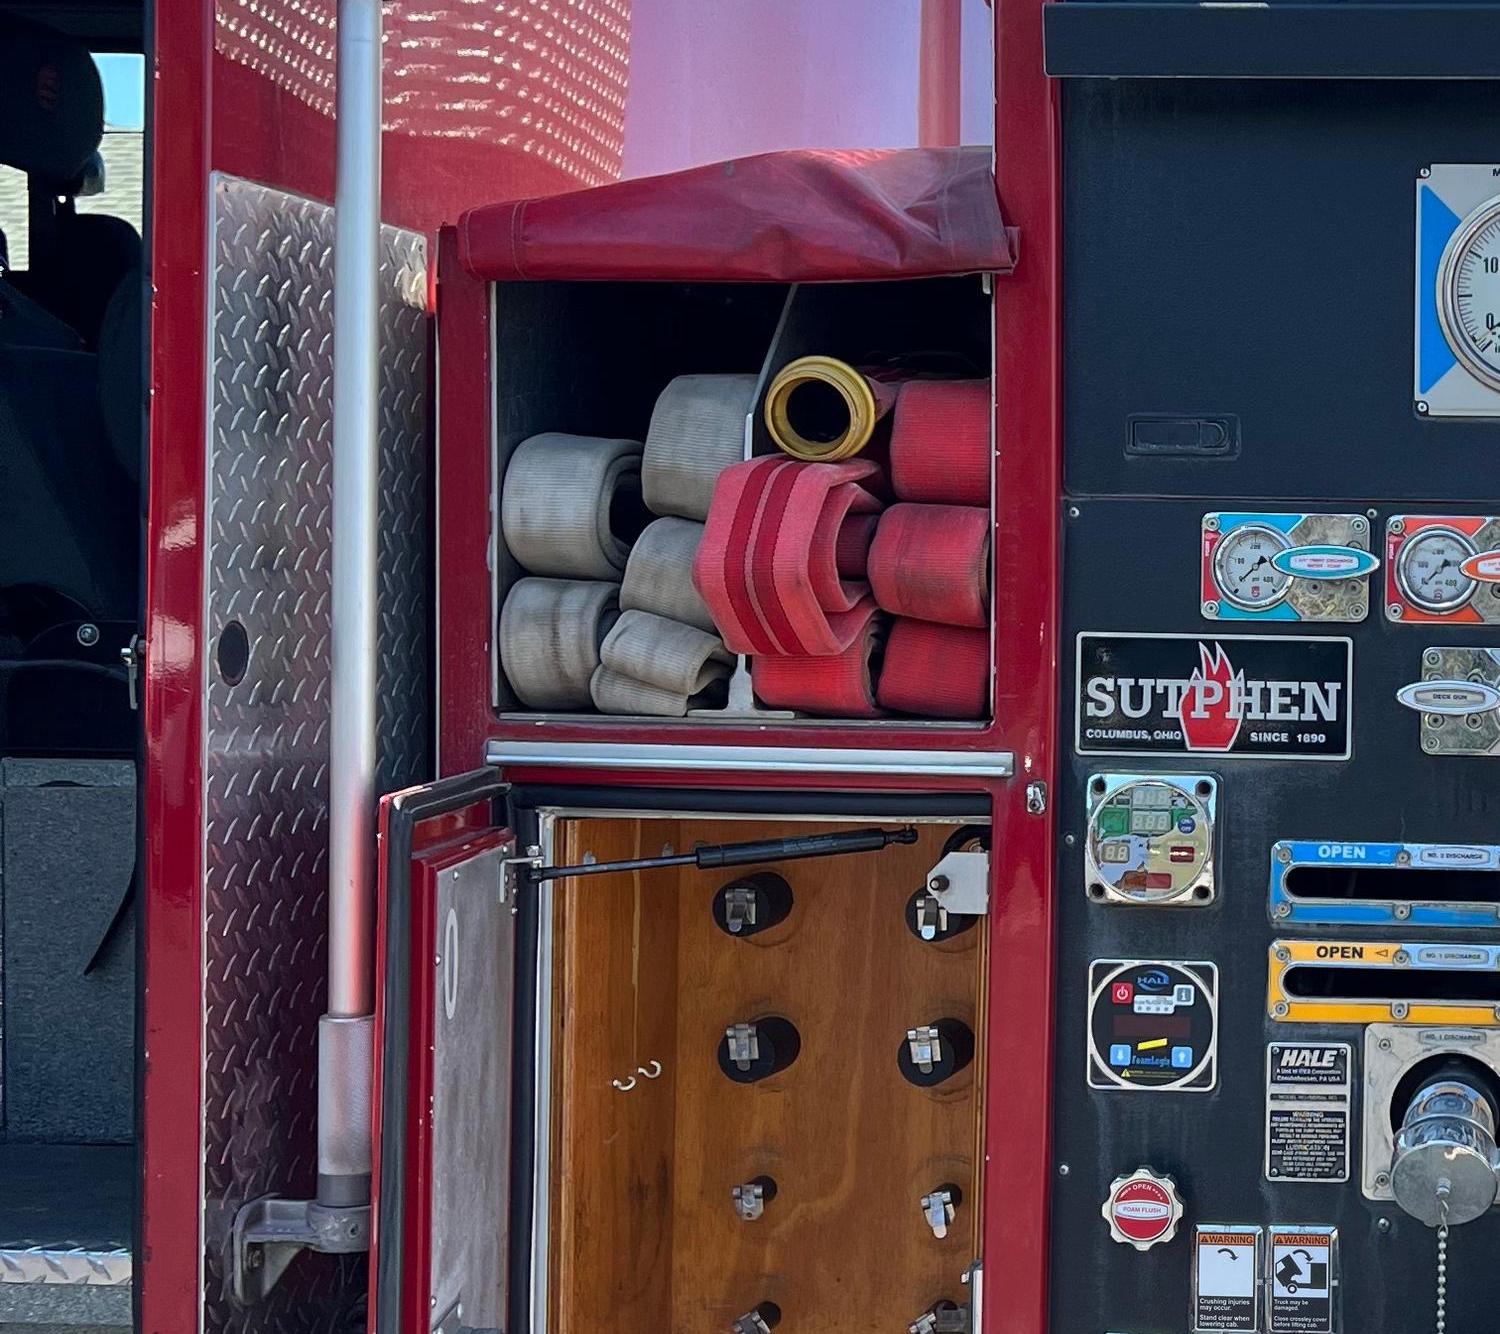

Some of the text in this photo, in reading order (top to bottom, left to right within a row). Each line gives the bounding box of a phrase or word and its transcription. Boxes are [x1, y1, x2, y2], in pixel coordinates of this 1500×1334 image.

[1486, 313, 1495, 330] 0
[1086, 676, 1342, 722] SUTPHEN
[1453, 693, 1468, 701] GUN
[1085, 728, 1327, 744] COLUMBUS, OHIO SINCE 1890
[1318, 845, 1366, 859] OPEN
[1316, 946, 1364, 959] OPEN
[1443, 1034, 1481, 1042] DISCHARGE
[1280, 1049, 1338, 1067] HALE
[1132, 1184, 1153, 1192] OPEN
[1141, 1206, 1162, 1214] FLUSH
[1209, 1235, 1254, 1245] WARNING
[1284, 1235, 1328, 1245] WARNING
[1199, 1298, 1250, 1306] Crushing injuries
